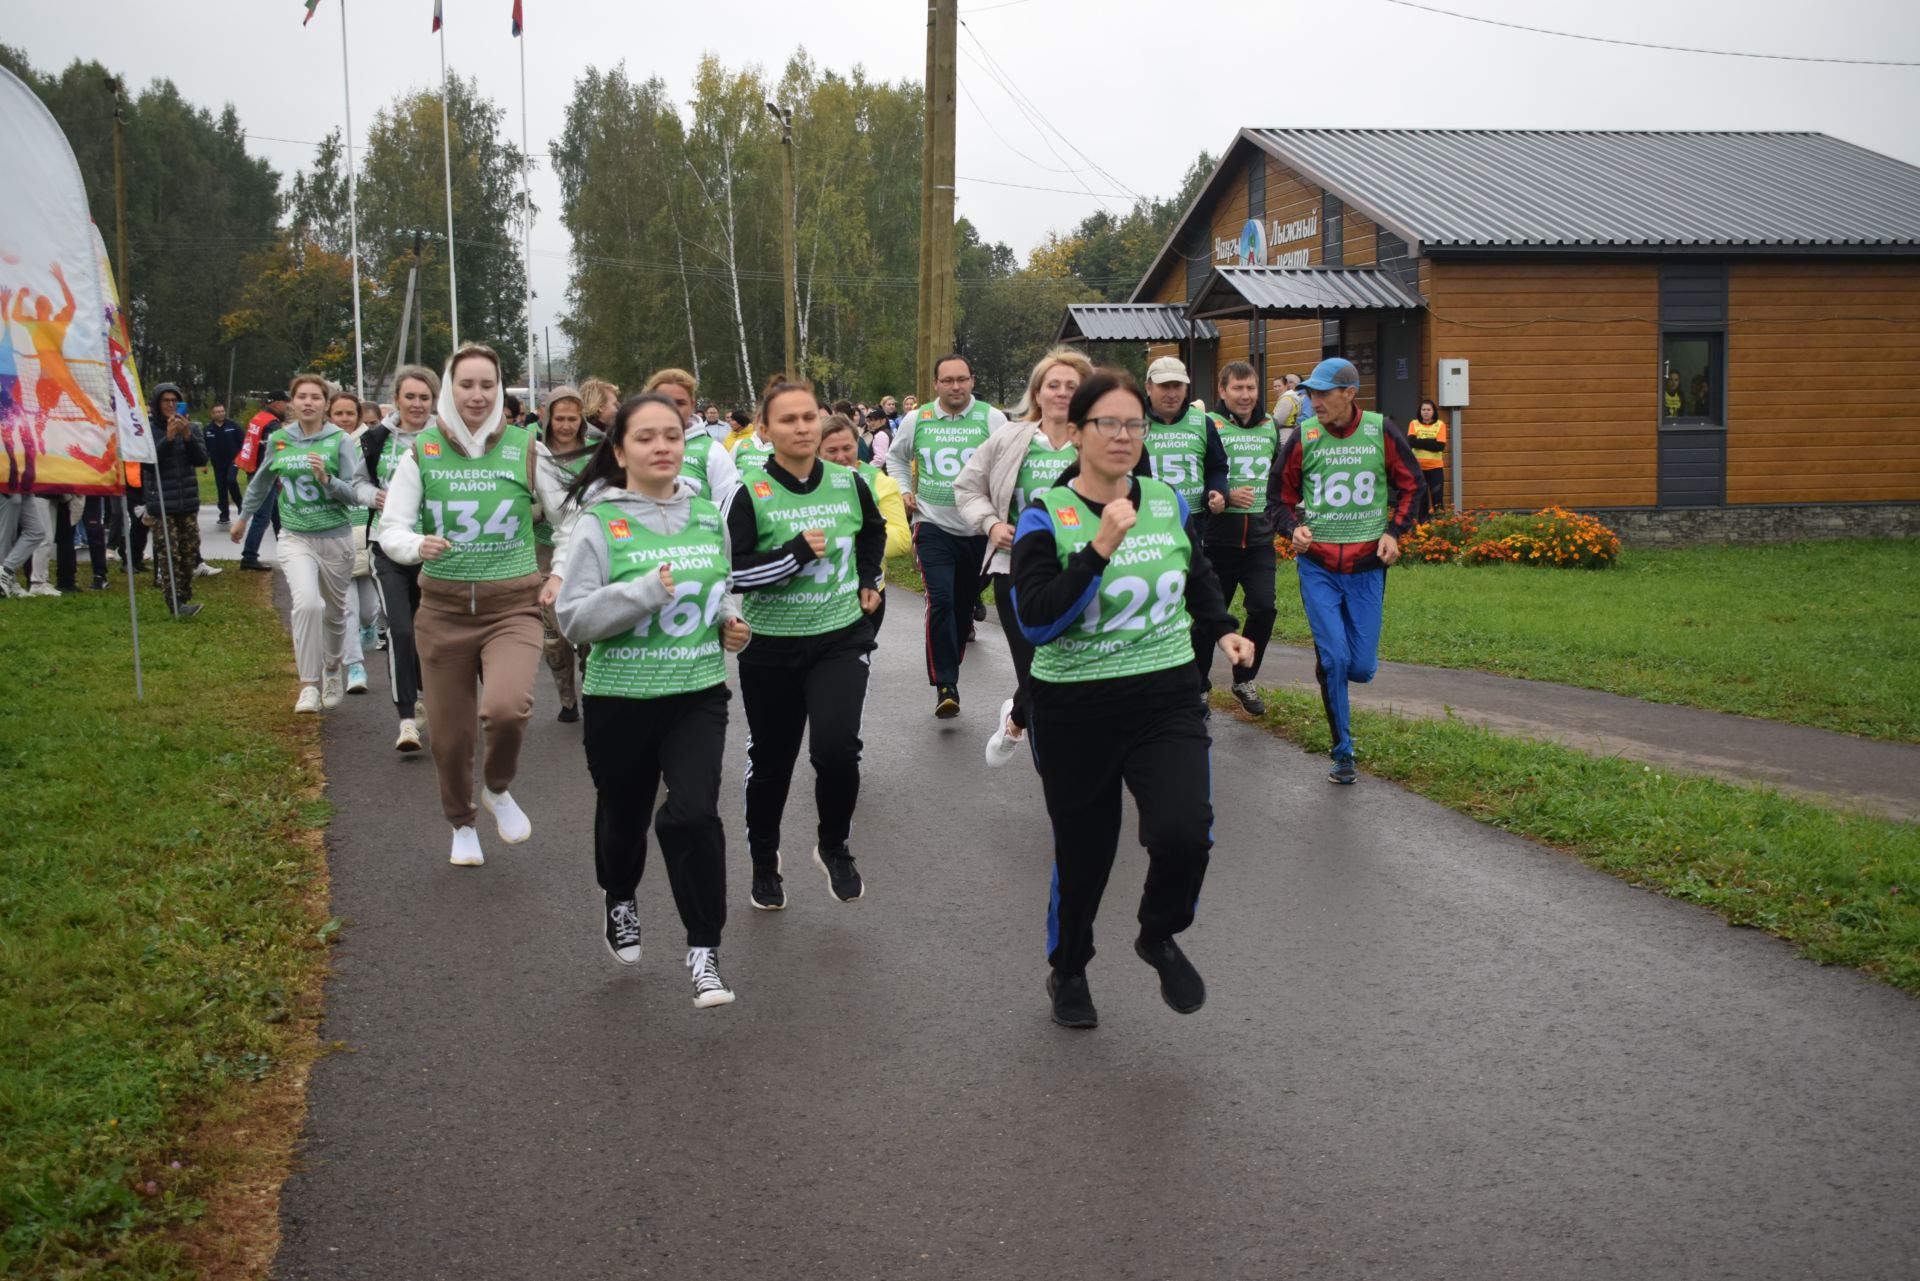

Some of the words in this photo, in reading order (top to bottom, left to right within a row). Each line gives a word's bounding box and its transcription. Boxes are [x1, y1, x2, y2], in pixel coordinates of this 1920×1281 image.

[1270, 208, 1318, 246] Лыжный
[924, 427, 981, 435] ТУКАЕВСКИЙ
[1154, 440, 1188, 449] РАЙОН
[1233, 443, 1262, 451] РАЙОН
[1313, 445, 1377, 458] ТУКАЕВСКИЙ
[288, 462, 312, 470] РАЙО
[1325, 455, 1362, 466] РАЙОН
[429, 469, 515, 480] ТУКАЕВСКИЙ
[450, 480, 497, 492] РАЙОН
[1309, 471, 1376, 507] 168
[767, 502, 851, 523] ТУКАЕВСКИЙ
[426, 499, 520, 543] 134
[790, 517, 837, 533] РАЙОН
[1110, 548, 1163, 567] АЙОН
[1081, 570, 1186, 634] 128
[604, 647, 648, 660] СПОРТ
